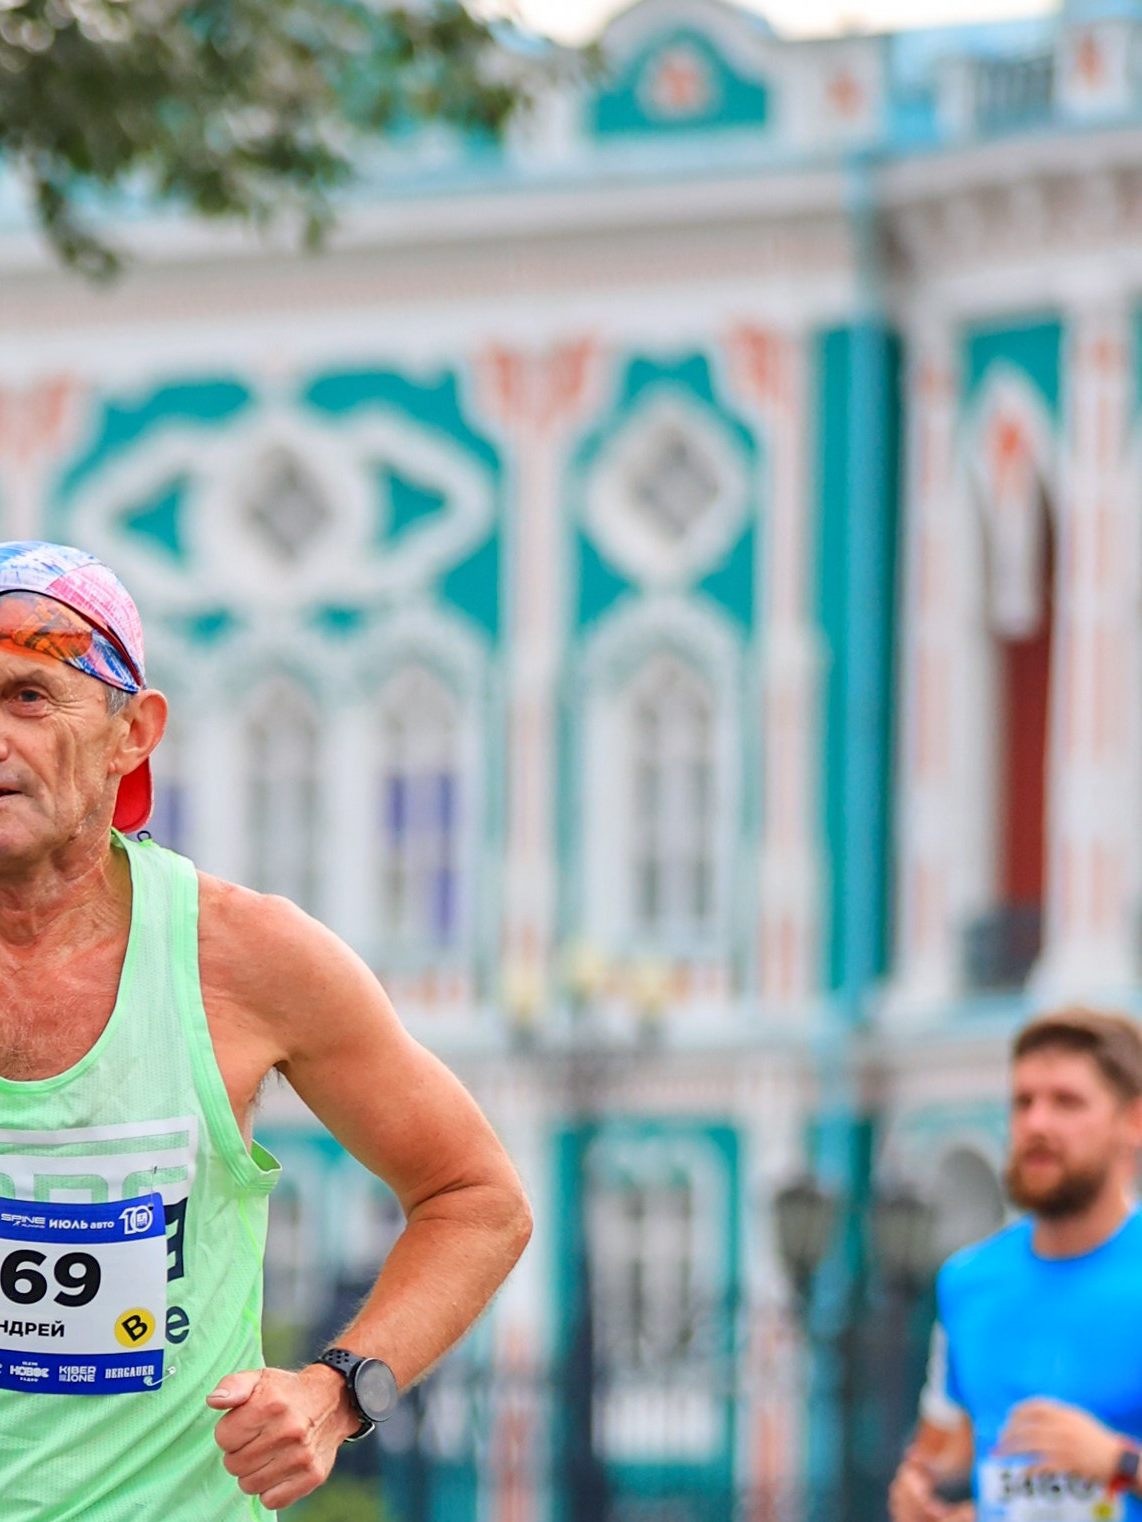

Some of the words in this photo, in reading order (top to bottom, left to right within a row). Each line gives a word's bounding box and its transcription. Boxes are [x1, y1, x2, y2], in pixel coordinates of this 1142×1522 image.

[1, 1213, 46, 1225] SPINE
[49, 1219, 88, 1230] ИЮЛЬ
[90, 1221, 115, 1230] авто
[104, 1365, 155, 1379] BERGAUER
